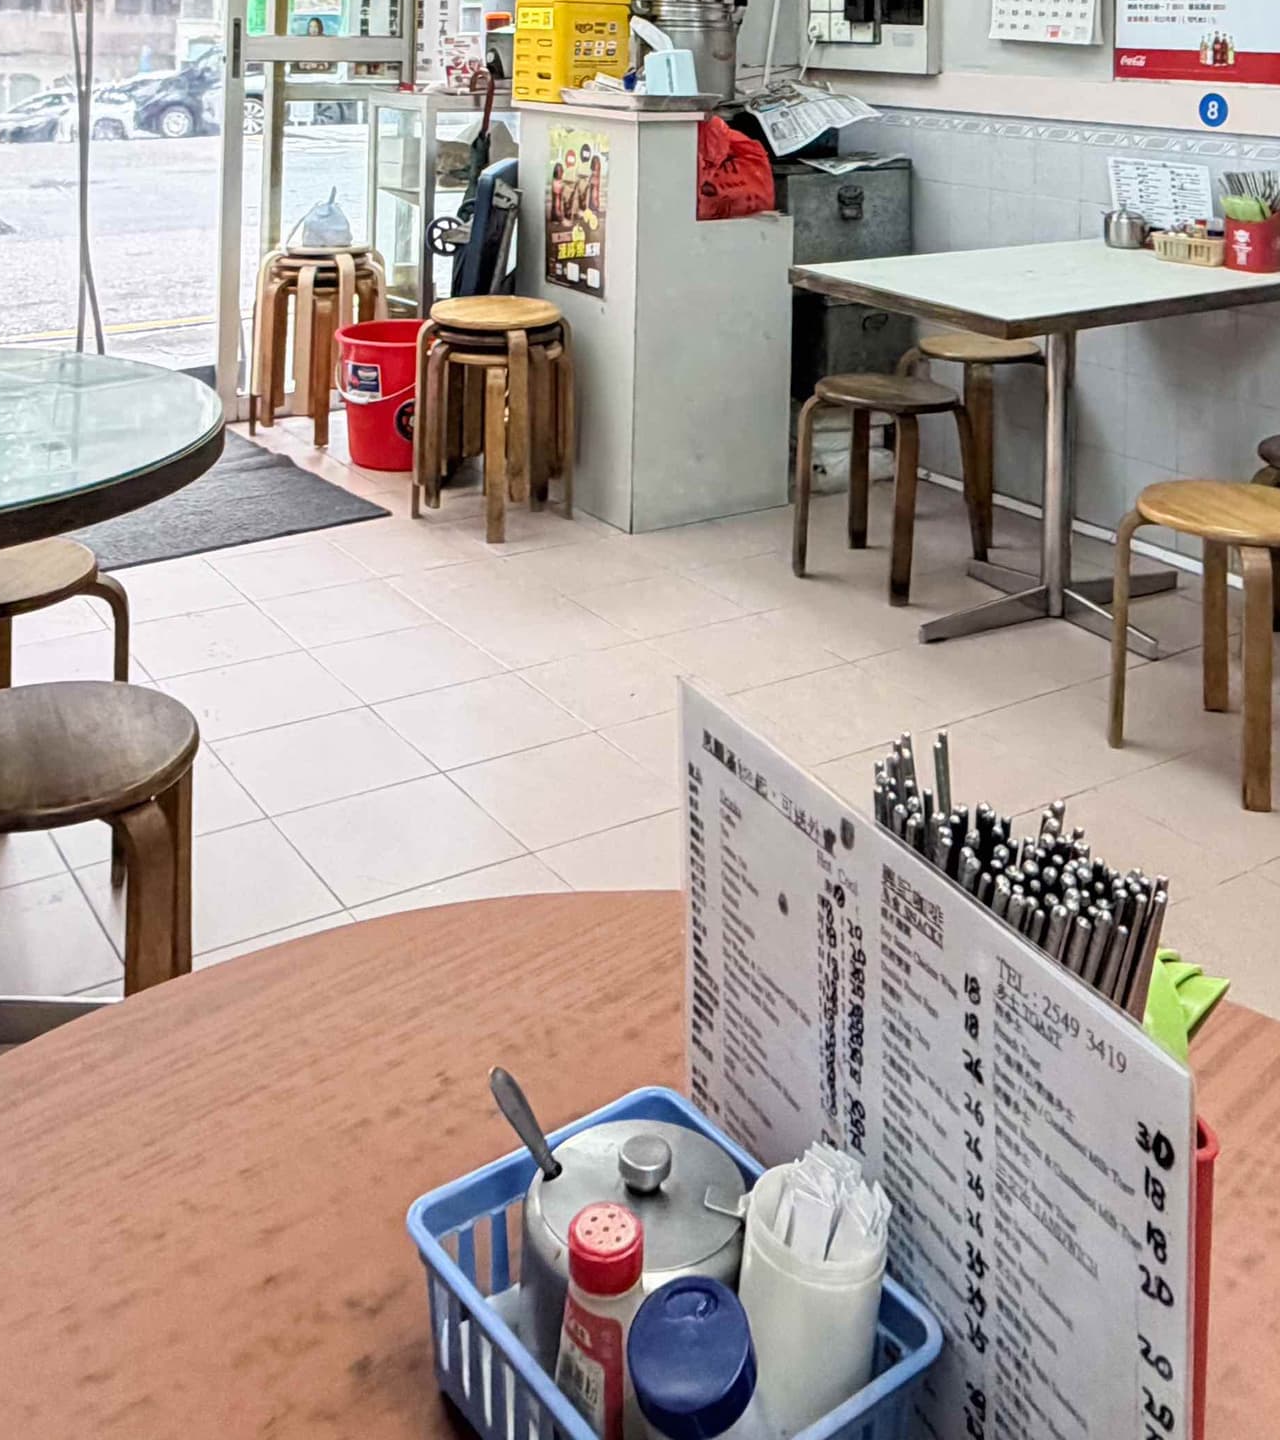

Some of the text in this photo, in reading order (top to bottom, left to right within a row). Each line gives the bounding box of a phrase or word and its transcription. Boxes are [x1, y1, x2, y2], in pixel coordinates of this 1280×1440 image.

[1207, 101, 1219, 120] 8
[964, 968, 980, 1009] 18
[964, 1005, 978, 1043] 18
[1043, 992, 1079, 1043] 2549
[1086, 1024, 1126, 1080] 3419
[964, 1086, 984, 1130] 26
[964, 1123, 983, 1164] 26
[1136, 1111, 1175, 1178] 30
[967, 1163, 984, 1205] 26
[1144, 1164, 1165, 1216] 18
[967, 1199, 984, 1240] 26
[1147, 1217, 1167, 1269] 18
[1138, 1257, 1173, 1321] 20
[1137, 1329, 1172, 1387] 20
